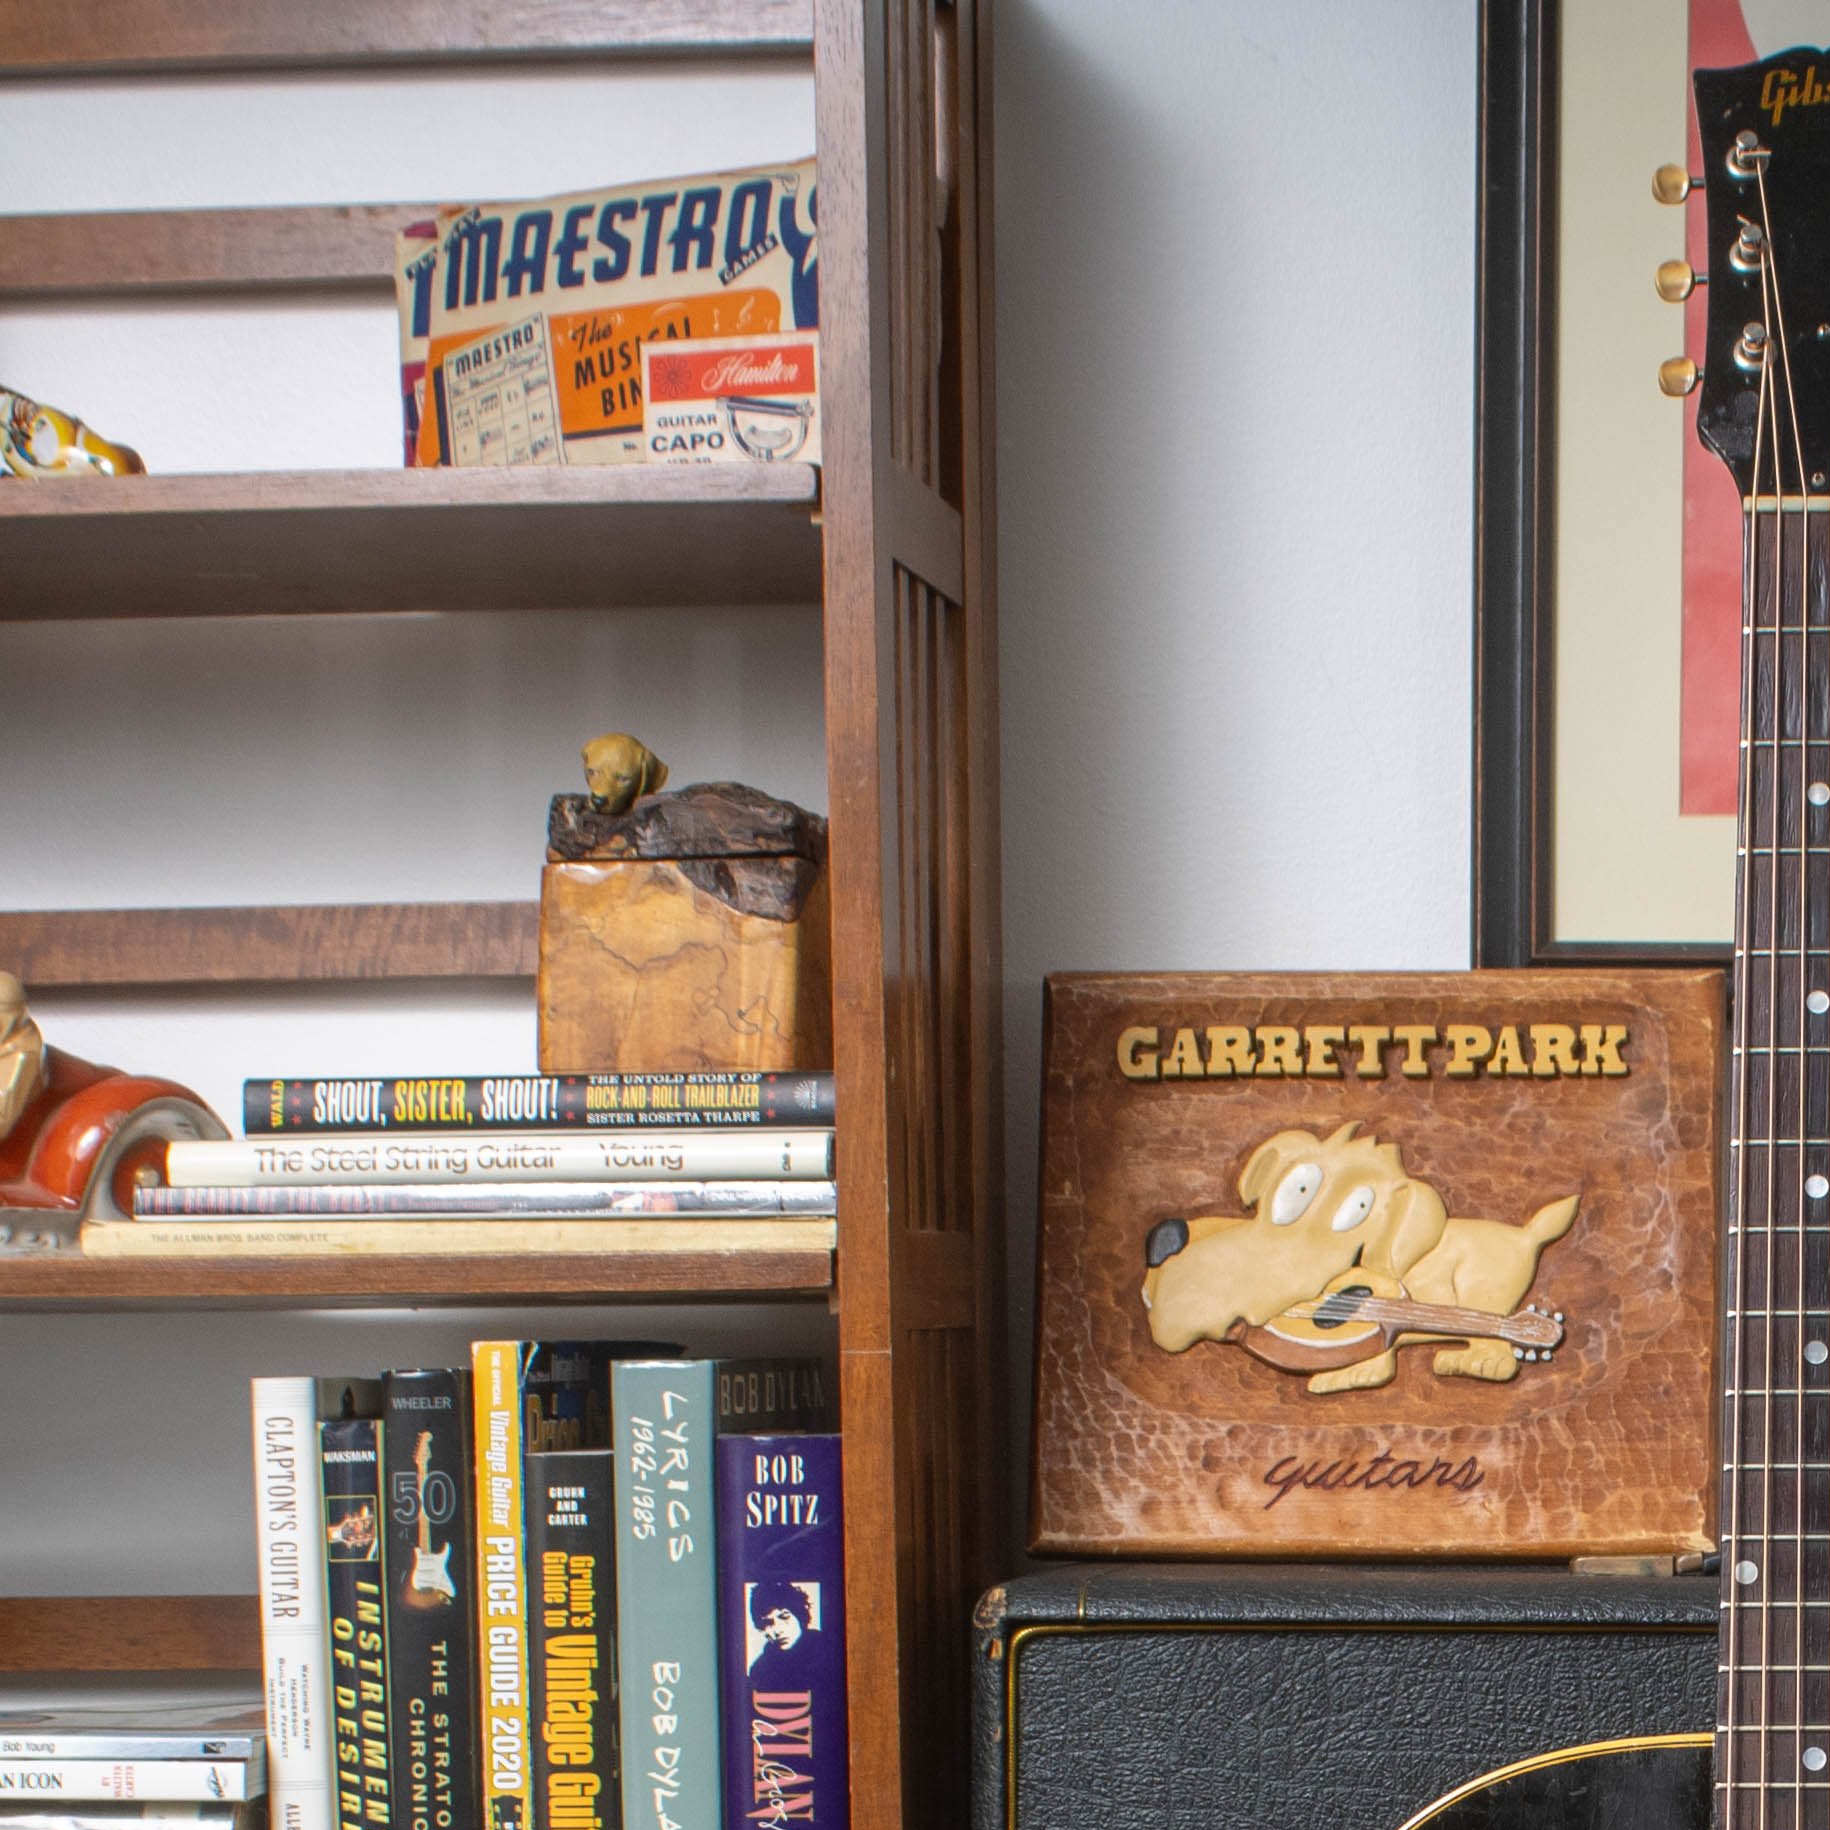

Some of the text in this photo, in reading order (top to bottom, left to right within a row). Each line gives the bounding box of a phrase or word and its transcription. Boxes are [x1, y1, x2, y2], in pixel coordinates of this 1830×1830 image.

[445, 178, 772, 311] MAESTRO
[700, 352, 800, 391] Hamilton
[651, 431, 725, 452] CAPO
[656, 413, 718, 428] GUITAR
[1445, 1024, 1631, 1079] PARK
[312, 1077, 560, 1127] SHOUT, SISTER, SHOUT!
[588, 1072, 763, 1085] THE UNTOLD STORY OF
[684, 1083, 760, 1109] TRAILBLAZER
[586, 1111, 761, 1125] SISTER ROSETTA THARPE
[254, 1143, 562, 1174] The Steel String Guitar
[598, 1143, 685, 1172] Young
[391, 1396, 453, 1410] WHEELER
[323, 1451, 377, 1463] WAKSMAN
[629, 1416, 657, 1541] 1962-1985
[659, 1390, 695, 1563] LYRICS
[754, 1454, 805, 1485] BOB
[1263, 1448, 1485, 1510] guitars
[263, 1415, 301, 1619] CLAPTON'S GUITAR
[392, 1470, 457, 1525] 50
[546, 1513, 589, 1526] CARTER
[555, 1500, 579, 1512] AND
[745, 1490, 820, 1529] SPITZ
[485, 1410, 523, 1790] Vintage Guitar PRICE GUIDE 2020
[543, 1551, 569, 1629] Guide to
[568, 1554, 597, 1629] Gruhn's
[332, 1616, 357, 1669] OF
[430, 1639, 450, 1697] THE
[542, 1633, 600, 1767] Vintage
[652, 1660, 682, 1736] BOB
[21, 1771, 64, 1790] ICON
[744, 1689, 816, 1823] DYLAN
